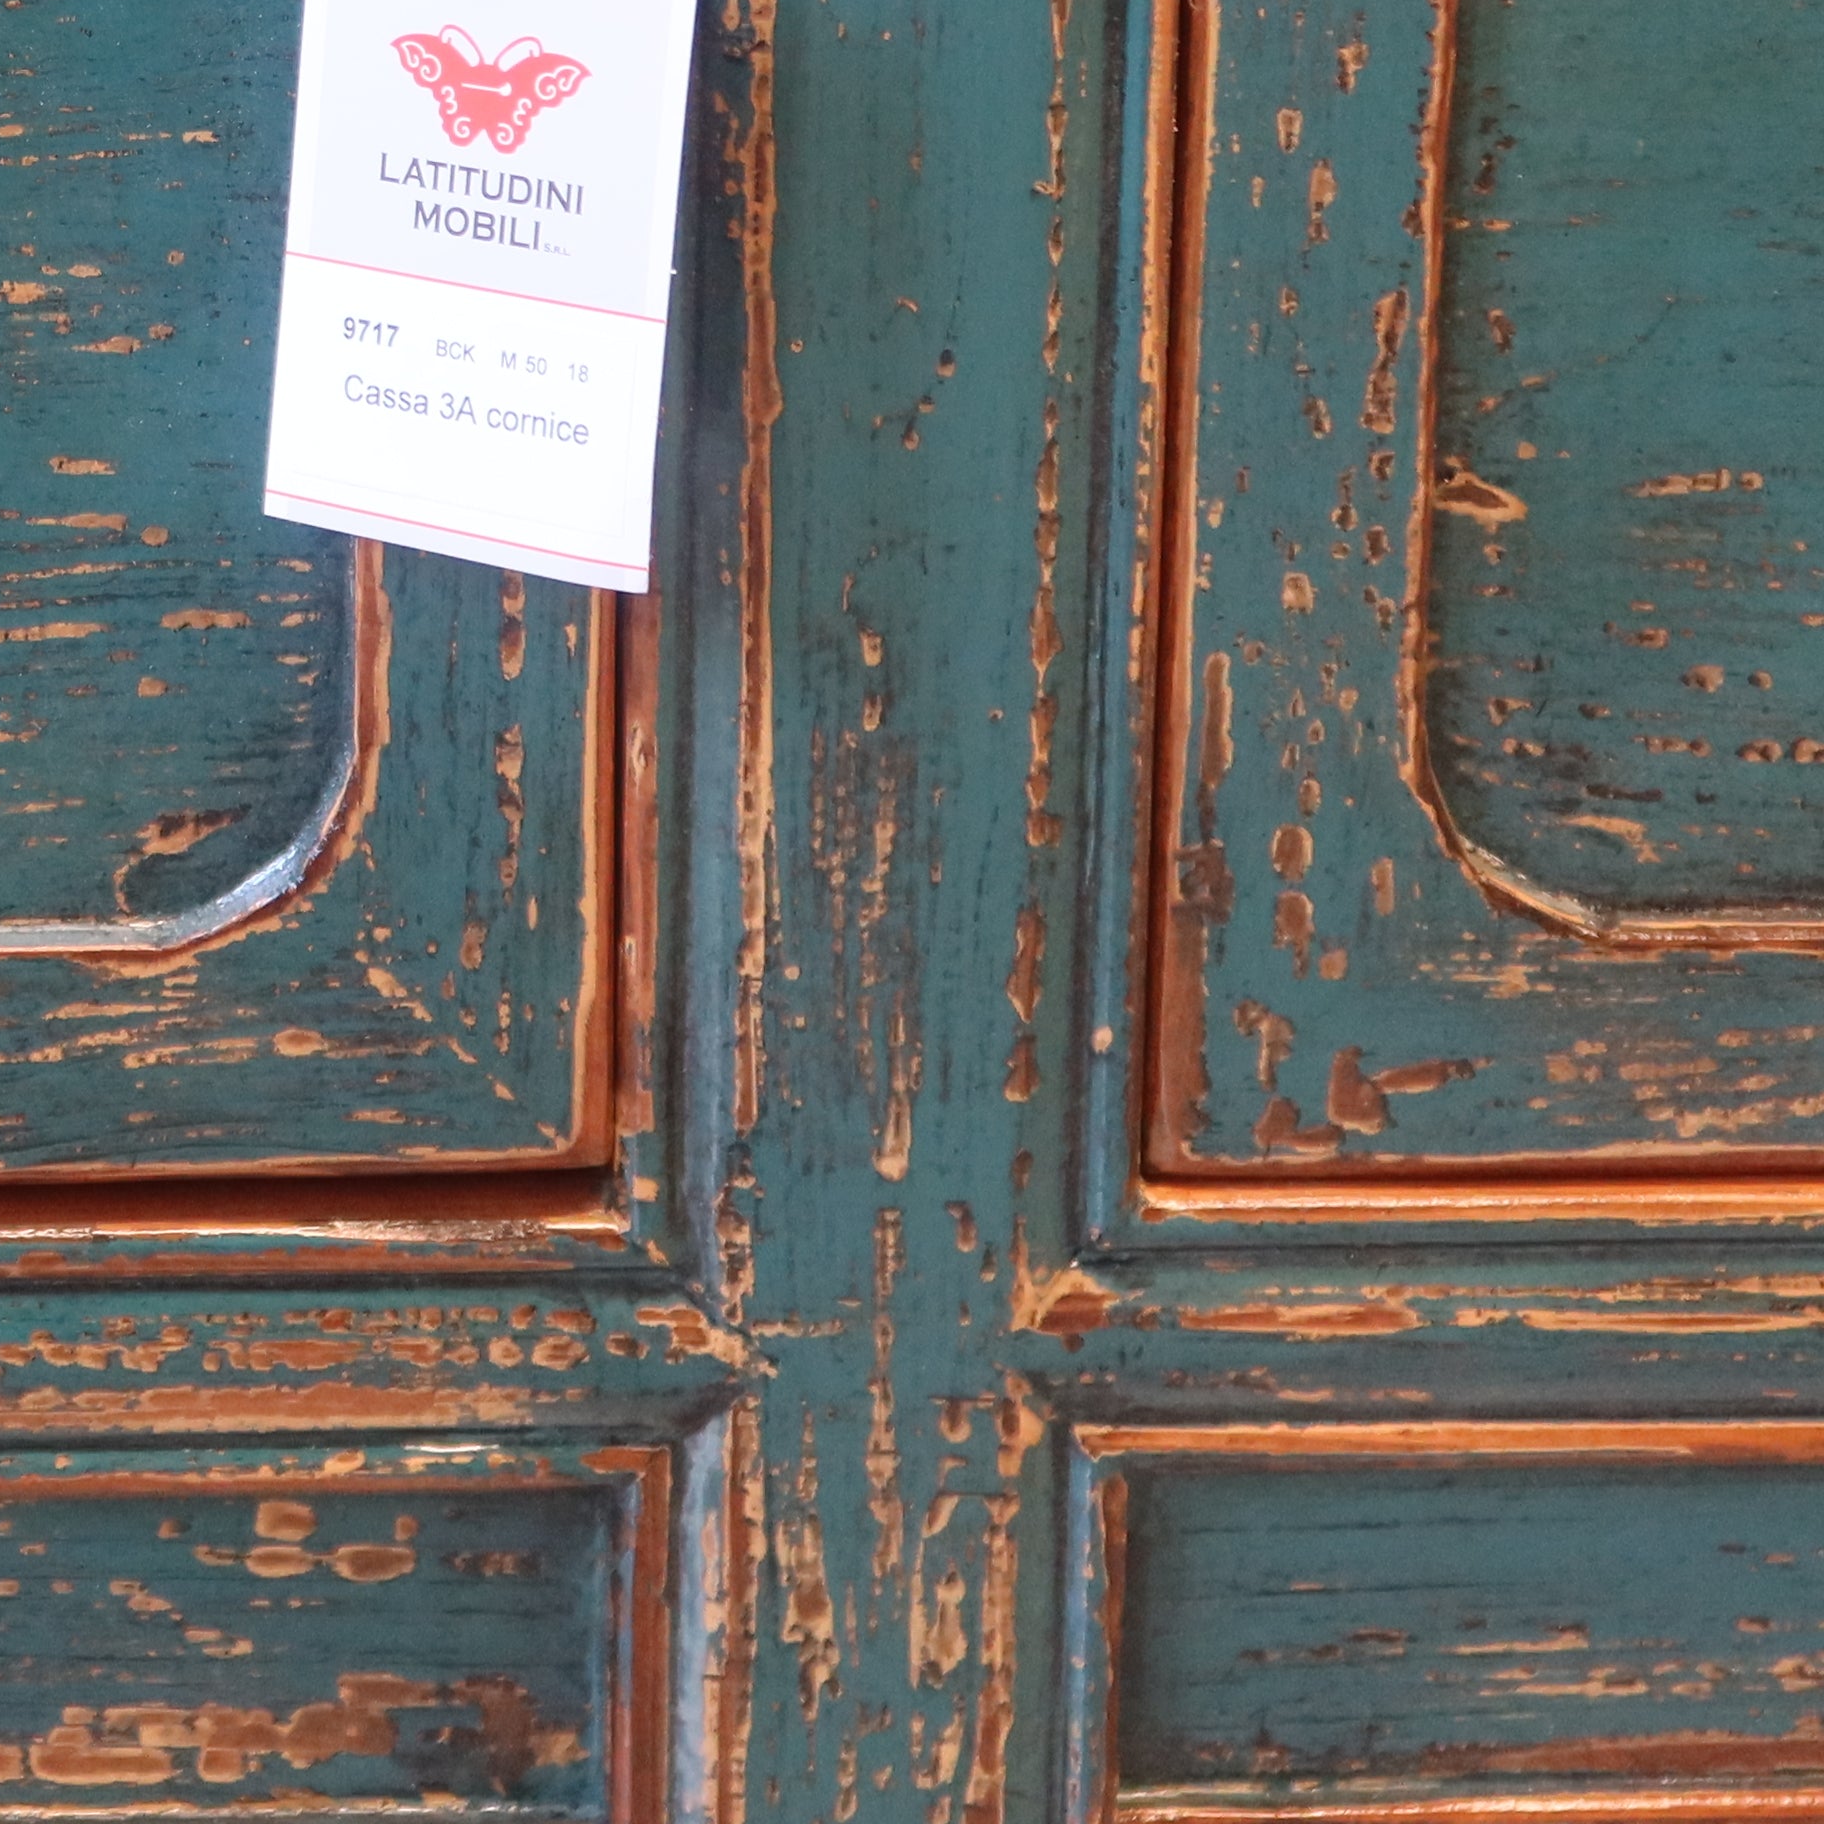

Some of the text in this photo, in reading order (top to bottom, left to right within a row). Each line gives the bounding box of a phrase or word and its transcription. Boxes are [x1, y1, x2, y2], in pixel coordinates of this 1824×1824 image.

[379, 152, 585, 215] LATITUDINI
[413, 200, 541, 251] MOBILI
[343, 316, 589, 383] 9717 BCK M 50 18
[343, 374, 590, 446] Cassa 3A cornice
